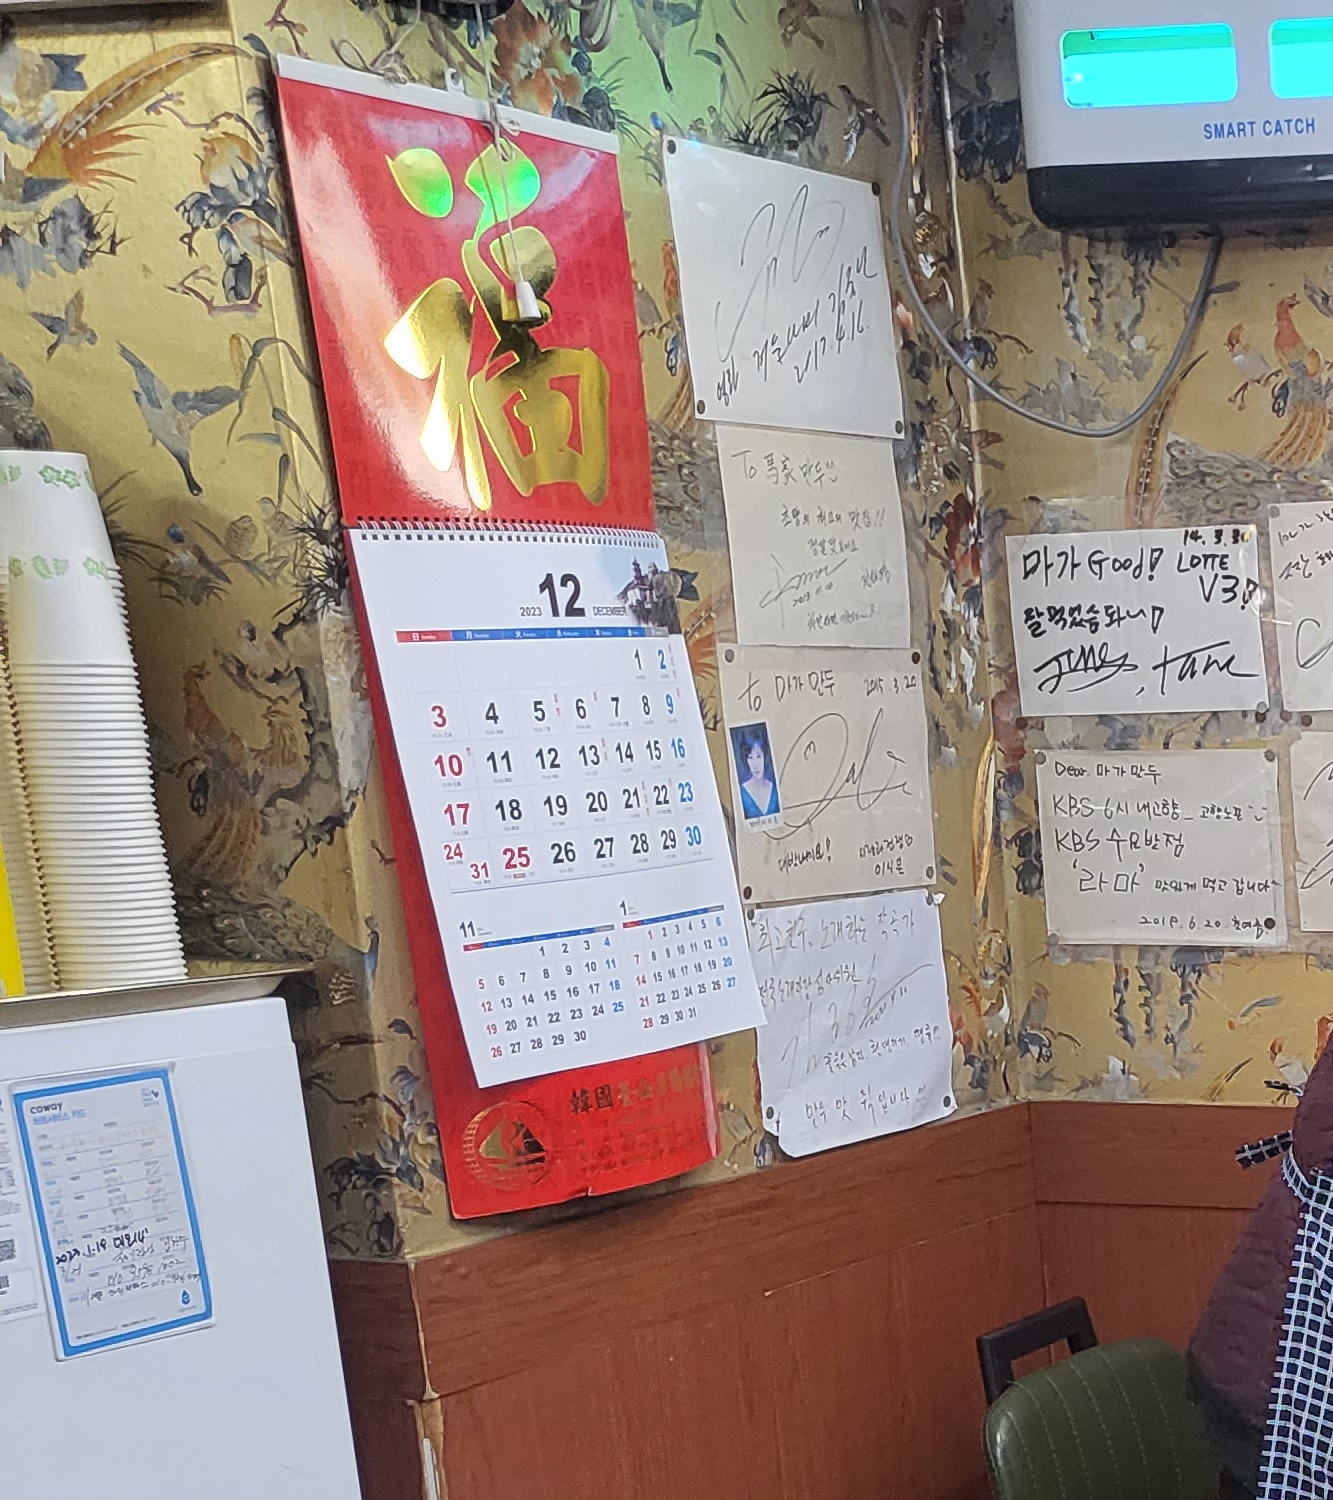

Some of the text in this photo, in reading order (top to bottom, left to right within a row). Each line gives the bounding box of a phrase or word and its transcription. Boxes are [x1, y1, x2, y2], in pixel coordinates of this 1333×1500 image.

[1203, 117, 1315, 140] SMART CATCH
[1022, 545, 1081, 586] 마가
[520, 606, 542, 617] 2023
[539, 573, 586, 618] 12
[635, 649, 666, 670] 1 2
[431, 694, 673, 728] 3 4 5 6 7 8 9
[435, 738, 685, 777] 10 11 12 13 14 15 16
[443, 782, 693, 826] 17 18 19 20 21 22 23
[1053, 793, 1095, 818] KBS
[444, 826, 701, 881] 24 31 25 26 27 28 29 30
[1054, 827, 1101, 852] KBS
[620, 900, 628, 916] 1
[459, 921, 476, 938] 11
